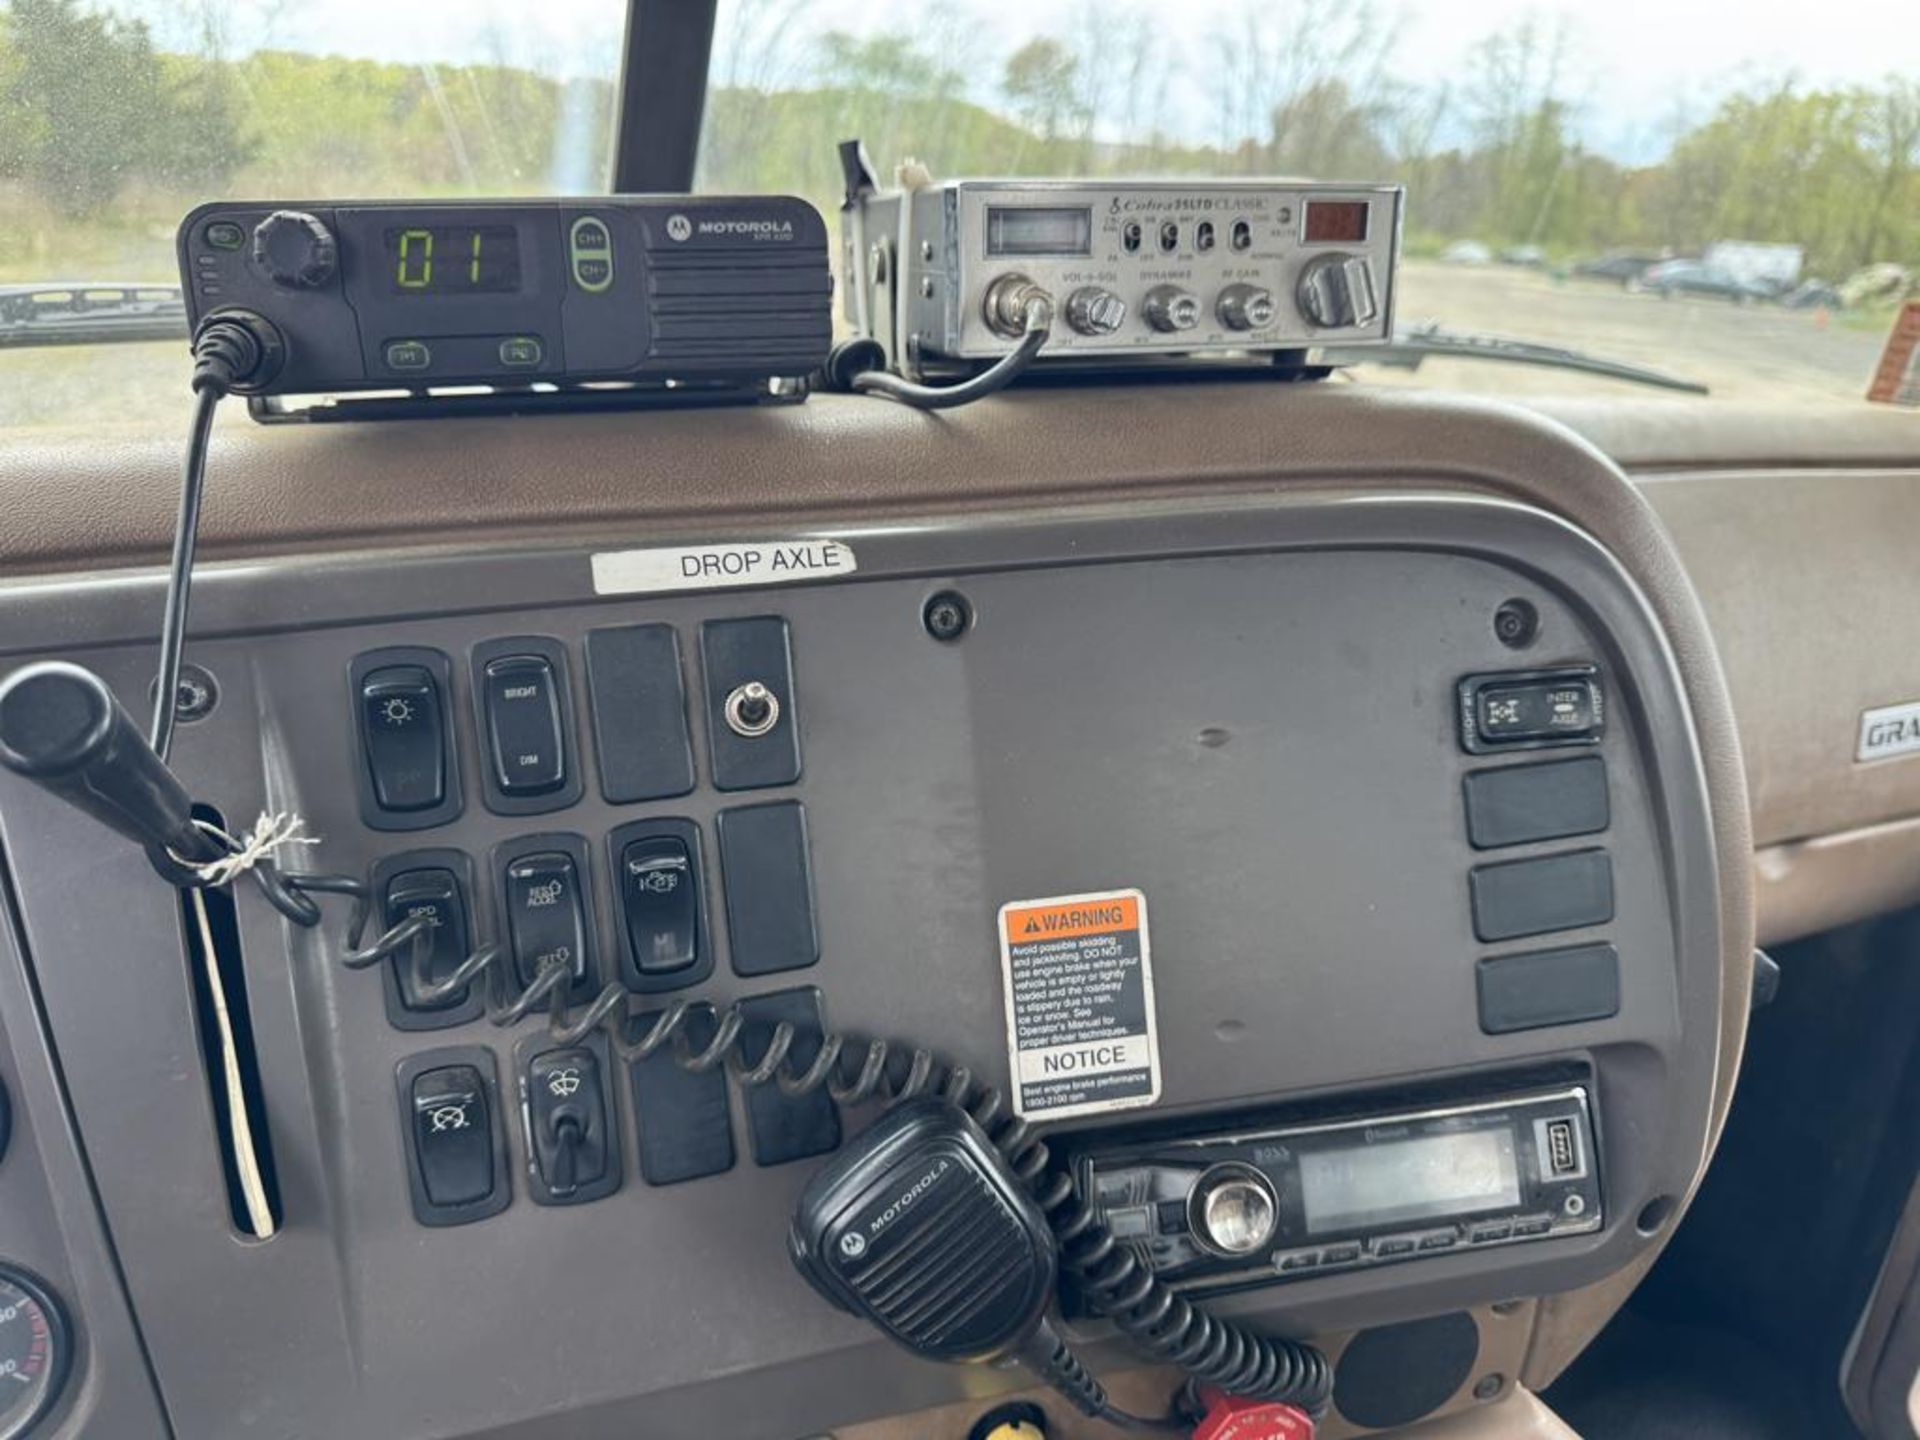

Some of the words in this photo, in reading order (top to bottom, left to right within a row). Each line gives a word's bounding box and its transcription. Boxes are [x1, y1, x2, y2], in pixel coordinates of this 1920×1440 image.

[1124, 200, 1174, 213] Cobra
[699, 221, 793, 234] MOTOROLA
[681, 551, 761, 577] DROP
[771, 545, 841, 571] AXLE
[504, 686, 537, 700] BRIGHT
[520, 755, 538, 766] DIM
[1041, 906, 1122, 931] WARNING
[1012, 944, 1037, 956] Avoid
[1040, 940, 1077, 955] possible
[1079, 936, 1116, 949] skidding
[1014, 957, 1030, 968] and
[1083, 947, 1100, 959] DO
[1101, 945, 1122, 958] NOT
[1014, 970, 1030, 979] use
[1032, 965, 1063, 977] engine
[1065, 962, 1090, 973] brake
[1093, 959, 1117, 969] when
[1119, 956, 1138, 969] your
[1015, 979, 1046, 991] vehicle
[1047, 979, 1056, 987] is
[1058, 973, 1086, 987] empty
[1087, 972, 1098, 981] or
[1099, 968, 1126, 982] lightly
[1016, 990, 1047, 1002] loaded
[1048, 987, 1066, 999] and
[1068, 986, 1082, 996] the
[1083, 982, 1122, 994] roadway
[1026, 999, 1062, 1013] slippery
[1063, 997, 1081, 1009] due
[1082, 995, 1092, 1006] to
[1018, 1016, 1031, 1026] ice
[1032, 1014, 1042, 1023] or
[1073, 1008, 1092, 1020] See
[1067, 1016, 1101, 1031] Manual
[1102, 1015, 1115, 1026] for
[1019, 1036, 1049, 1050] proper
[1051, 1033, 1077, 1045] driver
[1043, 1045, 1126, 1073] NOTICE
[1044, 1083, 1071, 1095] engine
[870, 1160, 949, 1232] MOTOROLA
